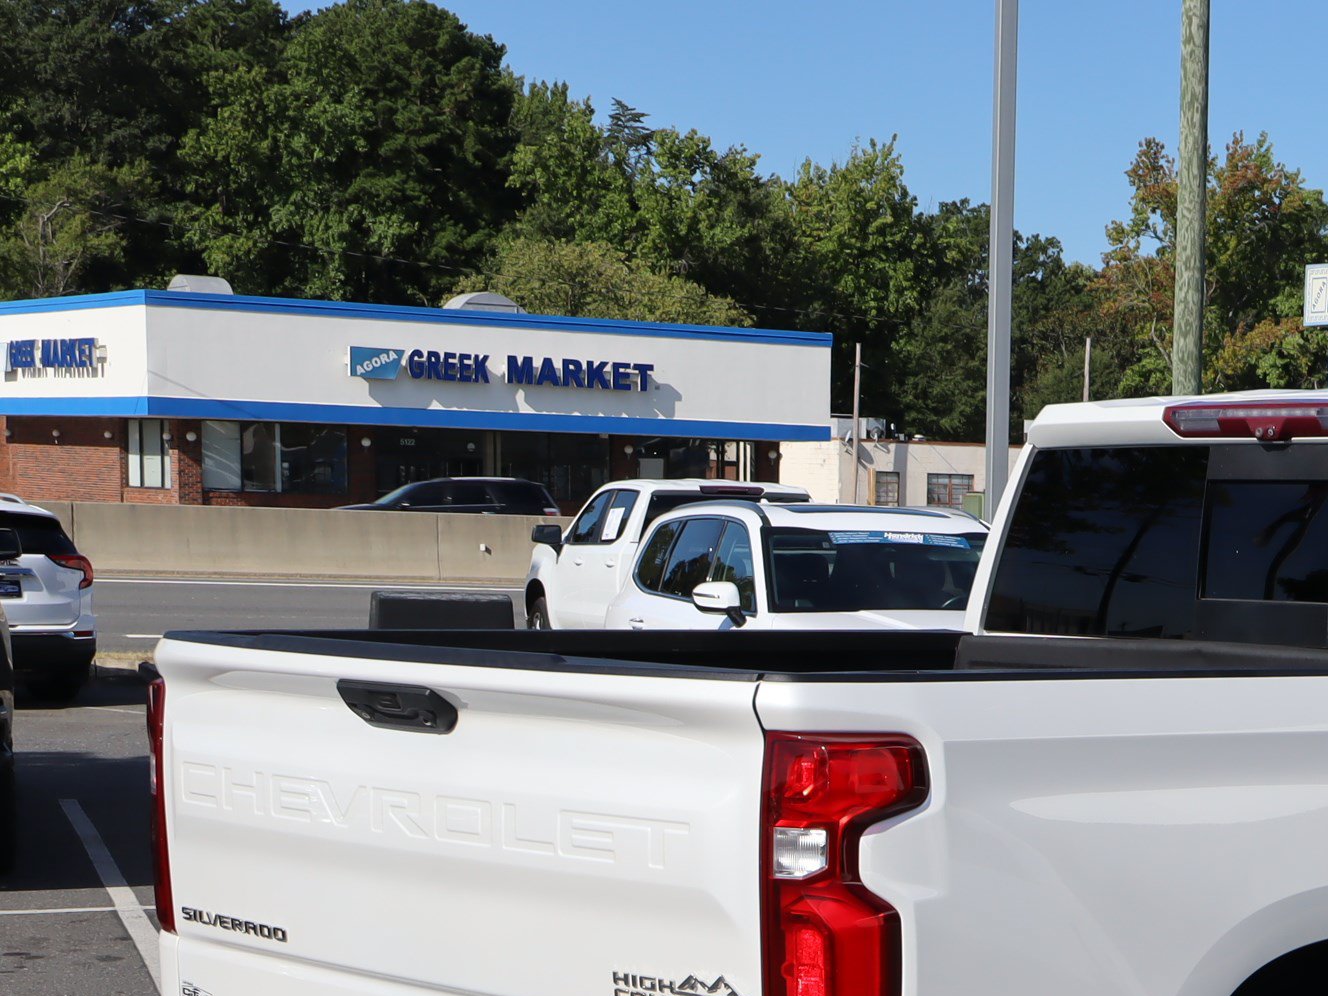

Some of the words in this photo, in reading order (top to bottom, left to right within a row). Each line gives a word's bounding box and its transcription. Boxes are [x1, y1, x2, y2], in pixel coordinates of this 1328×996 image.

[355, 350, 398, 375] AGORA
[408, 349, 490, 383] GREEK
[506, 355, 655, 392] MARKET
[181, 760, 692, 869] CHEVROLET
[181, 906, 288, 943] SILVERADO
[612, 971, 677, 994] HIGH
